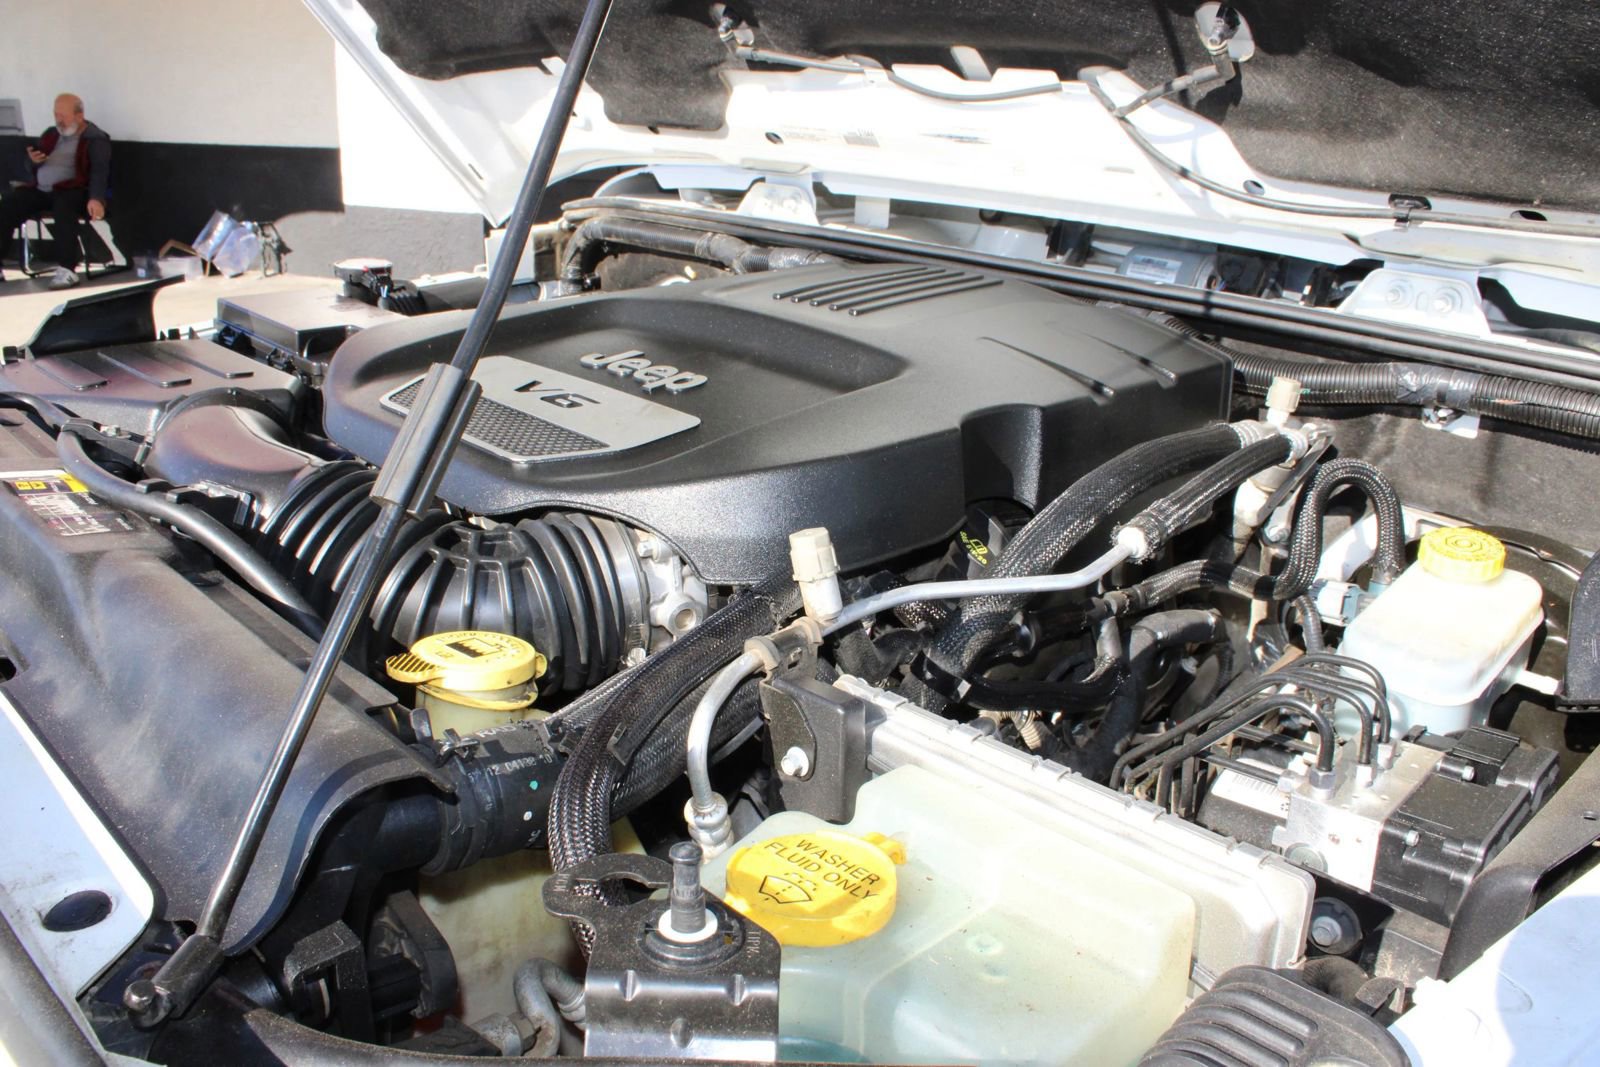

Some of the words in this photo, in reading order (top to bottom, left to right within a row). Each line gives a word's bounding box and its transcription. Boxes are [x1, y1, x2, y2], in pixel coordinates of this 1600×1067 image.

[514, 380, 602, 409] V6
[579, 350, 708, 395] Jeep
[764, 841, 821, 873] FLUID
[823, 872, 880, 899] ONLY
[796, 839, 880, 886] WASHER
